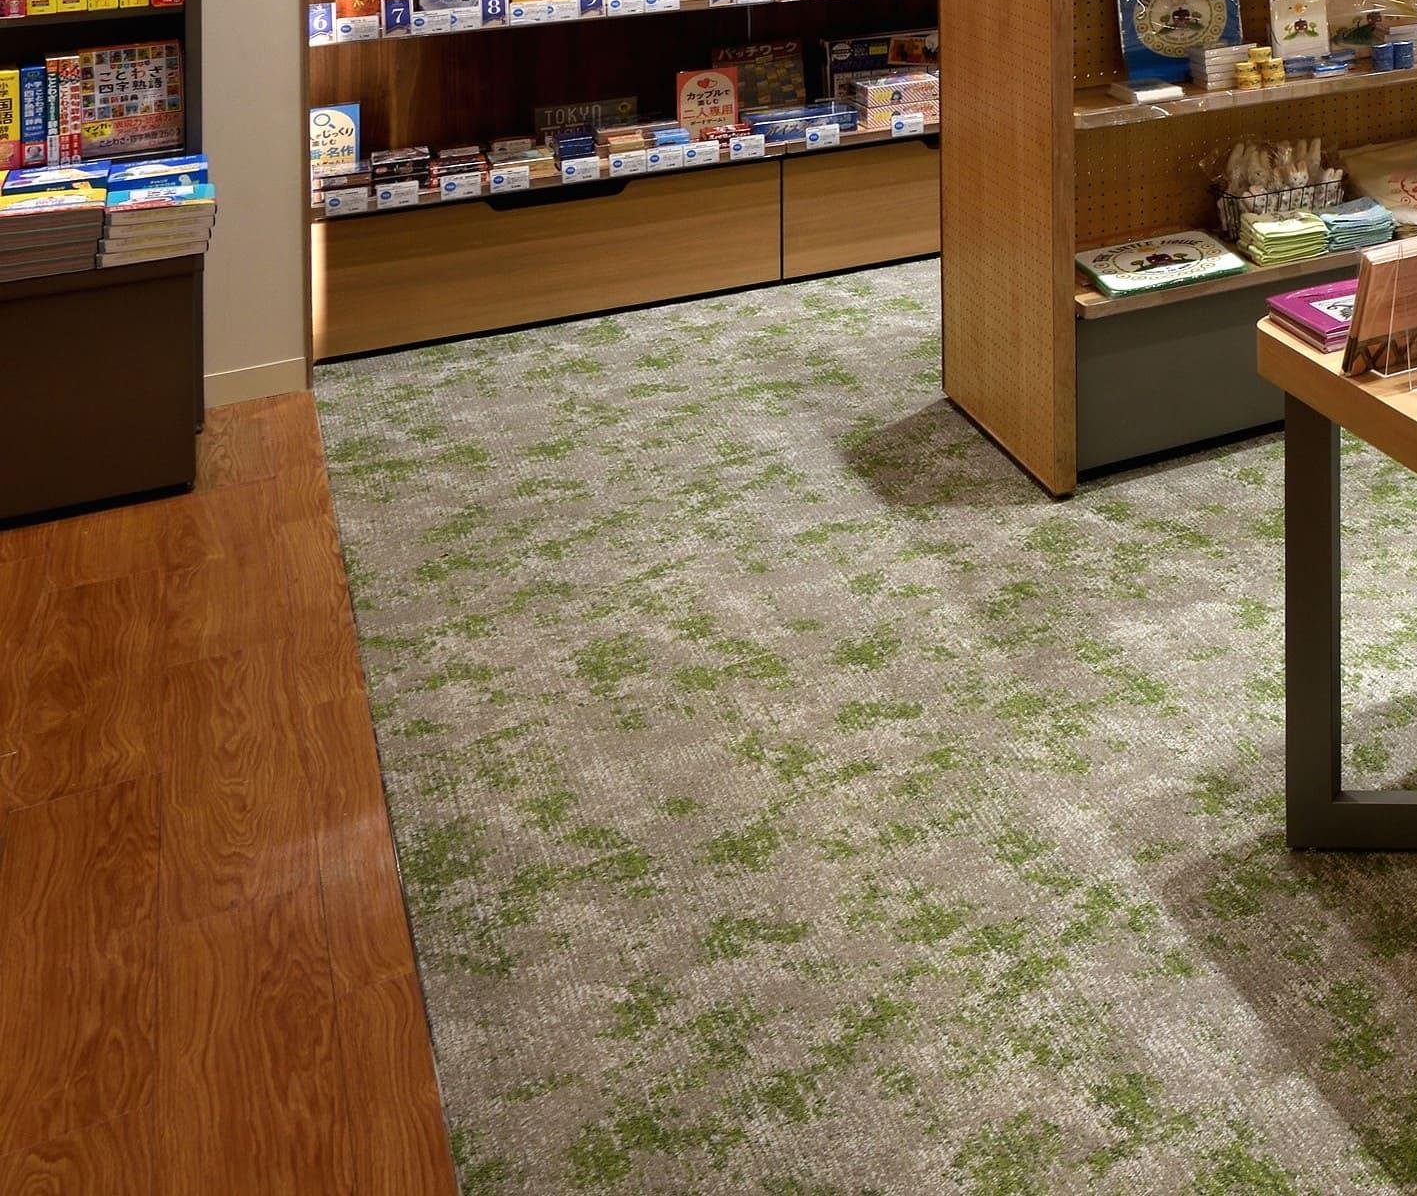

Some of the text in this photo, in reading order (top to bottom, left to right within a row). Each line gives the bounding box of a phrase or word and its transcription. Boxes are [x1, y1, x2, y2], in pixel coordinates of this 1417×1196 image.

[312, 12, 328, 31] 6
[391, 7, 405, 26] 7
[718, 41, 798, 60] パッチワーク
[97, 80, 164, 94] 四字熟語
[544, 105, 601, 127] TOKYO
